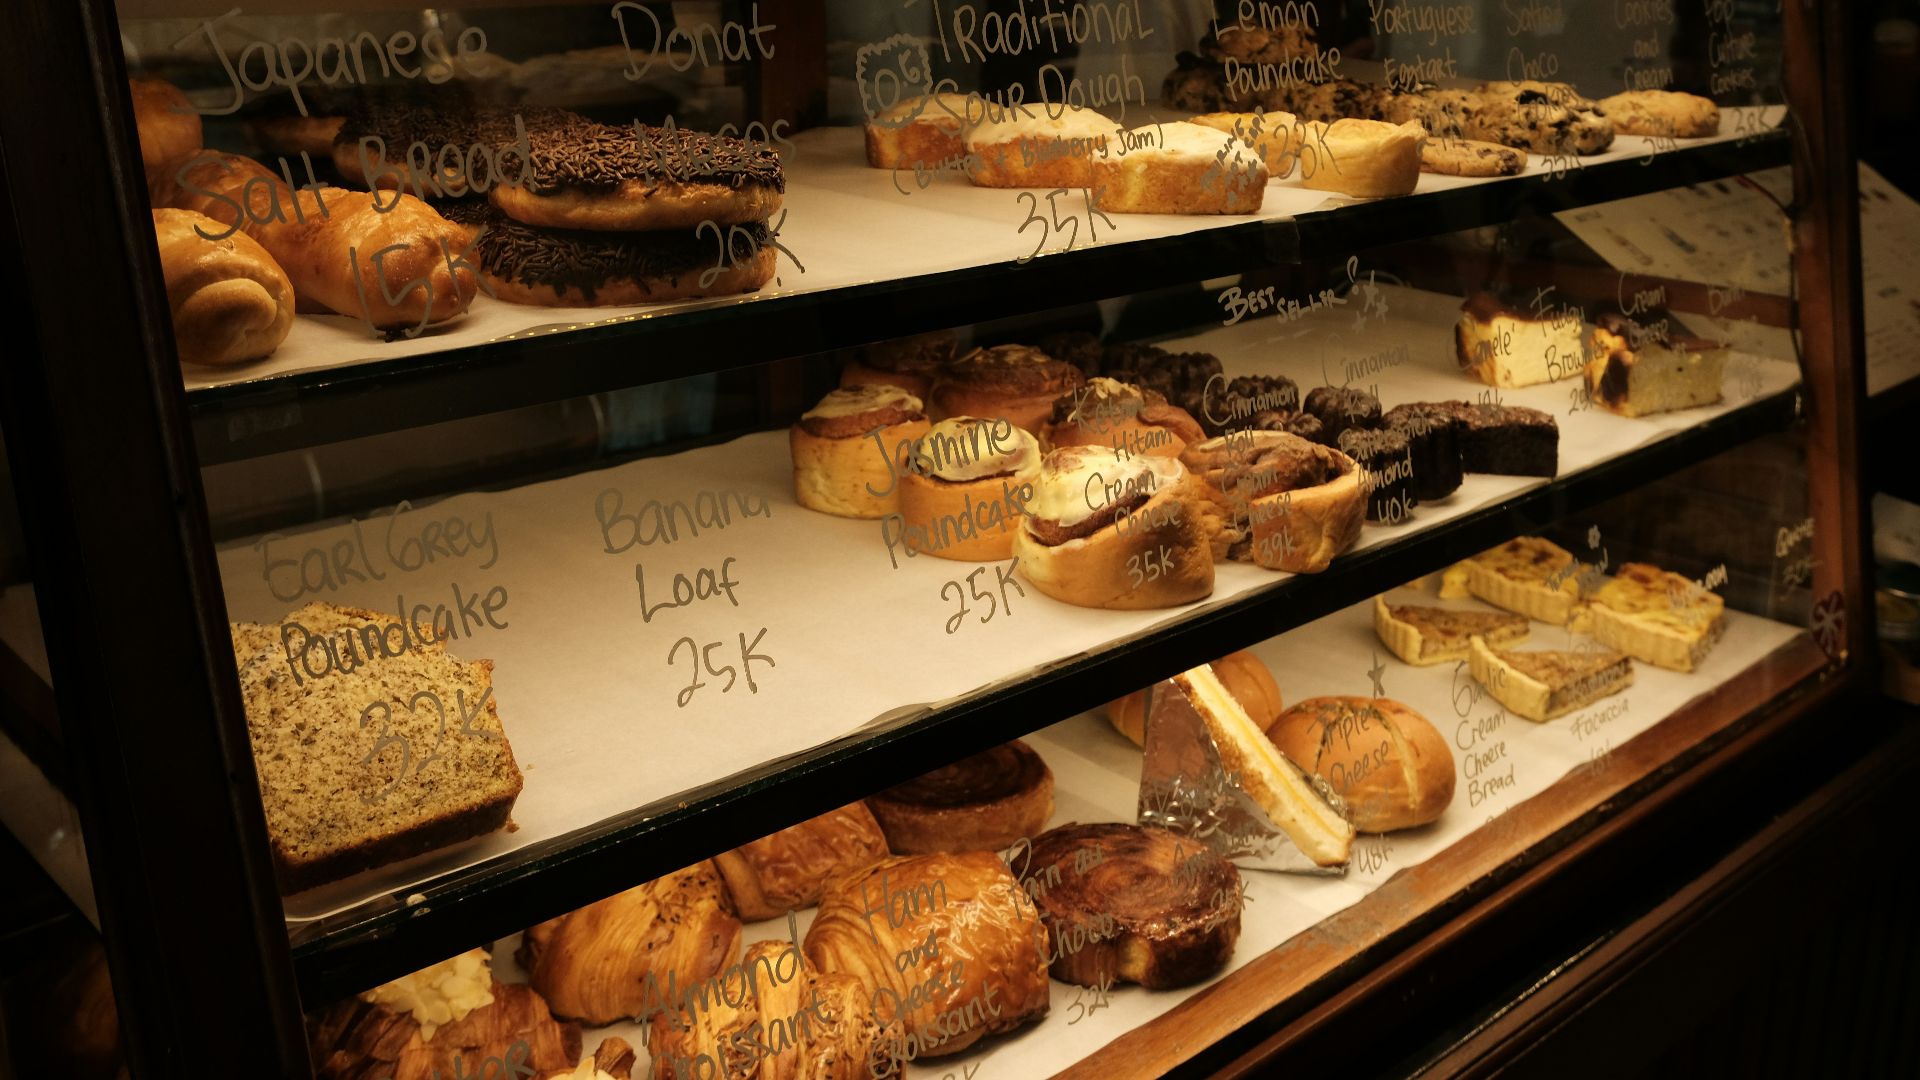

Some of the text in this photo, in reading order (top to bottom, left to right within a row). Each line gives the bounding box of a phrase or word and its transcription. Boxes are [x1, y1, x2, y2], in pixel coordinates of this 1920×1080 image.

[170, 7, 490, 117] Japanese
[612, 2, 776, 80] Donat
[1223, 44, 1345, 103] Poundcake
[1506, 47, 1559, 87] Choco
[1634, 28, 1660, 59] and
[1038, 55, 1147, 120] Dough
[175, 151, 332, 241] Salt
[1016, 184, 1117, 265] 35K
[349, 224, 504, 338] 15K
[695, 207, 806, 289] 20K
[863, 416, 1017, 497] Jasmine
[1112, 428, 1173, 463] Hitam
[1357, 447, 1414, 495] Almond
[594, 487, 772, 556] Banana
[881, 482, 1034, 570] Poundcake
[1085, 471, 1157, 512] Cream
[1114, 499, 1183, 540] Cheese
[635, 557, 741, 624] Loaf
[940, 556, 1026, 635] 25K
[280, 582, 509, 687] Poundcake
[667, 627, 777, 708] 25K
[1455, 709, 1508, 752] Cream
[1463, 740, 1508, 781] Cheese
[1329, 740, 1390, 795] Cheese
[1467, 766, 1516, 808] Bread
[861, 873, 948, 945] Ham
[1005, 837, 1063, 921] Pain
[895, 928, 940, 974] and
[1033, 911, 1114, 967] Choco
[634, 910, 808, 1047] Almond
[871, 960, 965, 1029] Cheese
